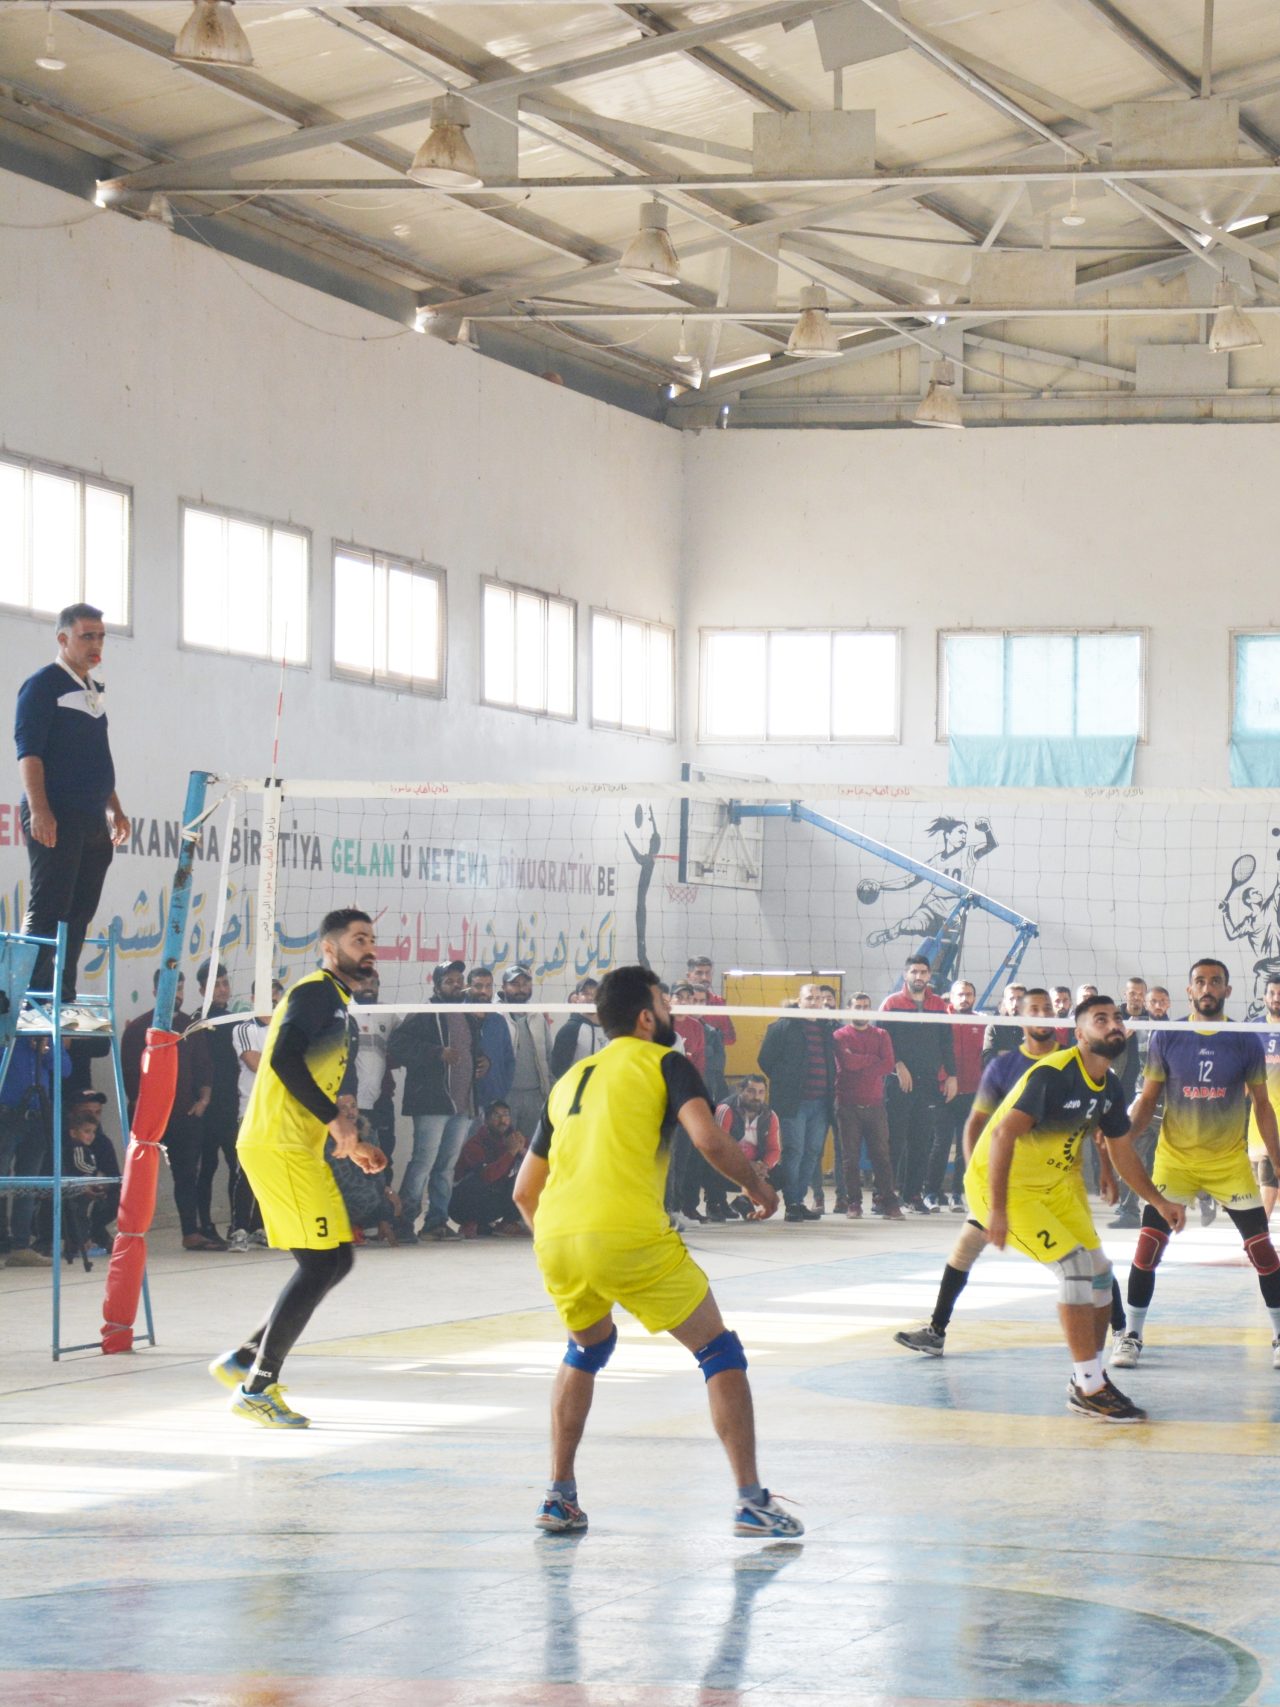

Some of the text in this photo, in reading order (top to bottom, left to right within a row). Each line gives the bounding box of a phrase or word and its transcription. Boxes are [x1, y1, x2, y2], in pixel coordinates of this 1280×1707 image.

[331, 837, 395, 878] GELAN
[597, 865, 615, 897] BE
[1267, 1039, 1277, 1054] 9
[1198, 1060, 1214, 1082] 12
[567, 1065, 597, 1116] 1
[1085, 1098, 1098, 1119] 2
[315, 1216, 329, 1238] 3
[1036, 1229, 1058, 1250] 2
